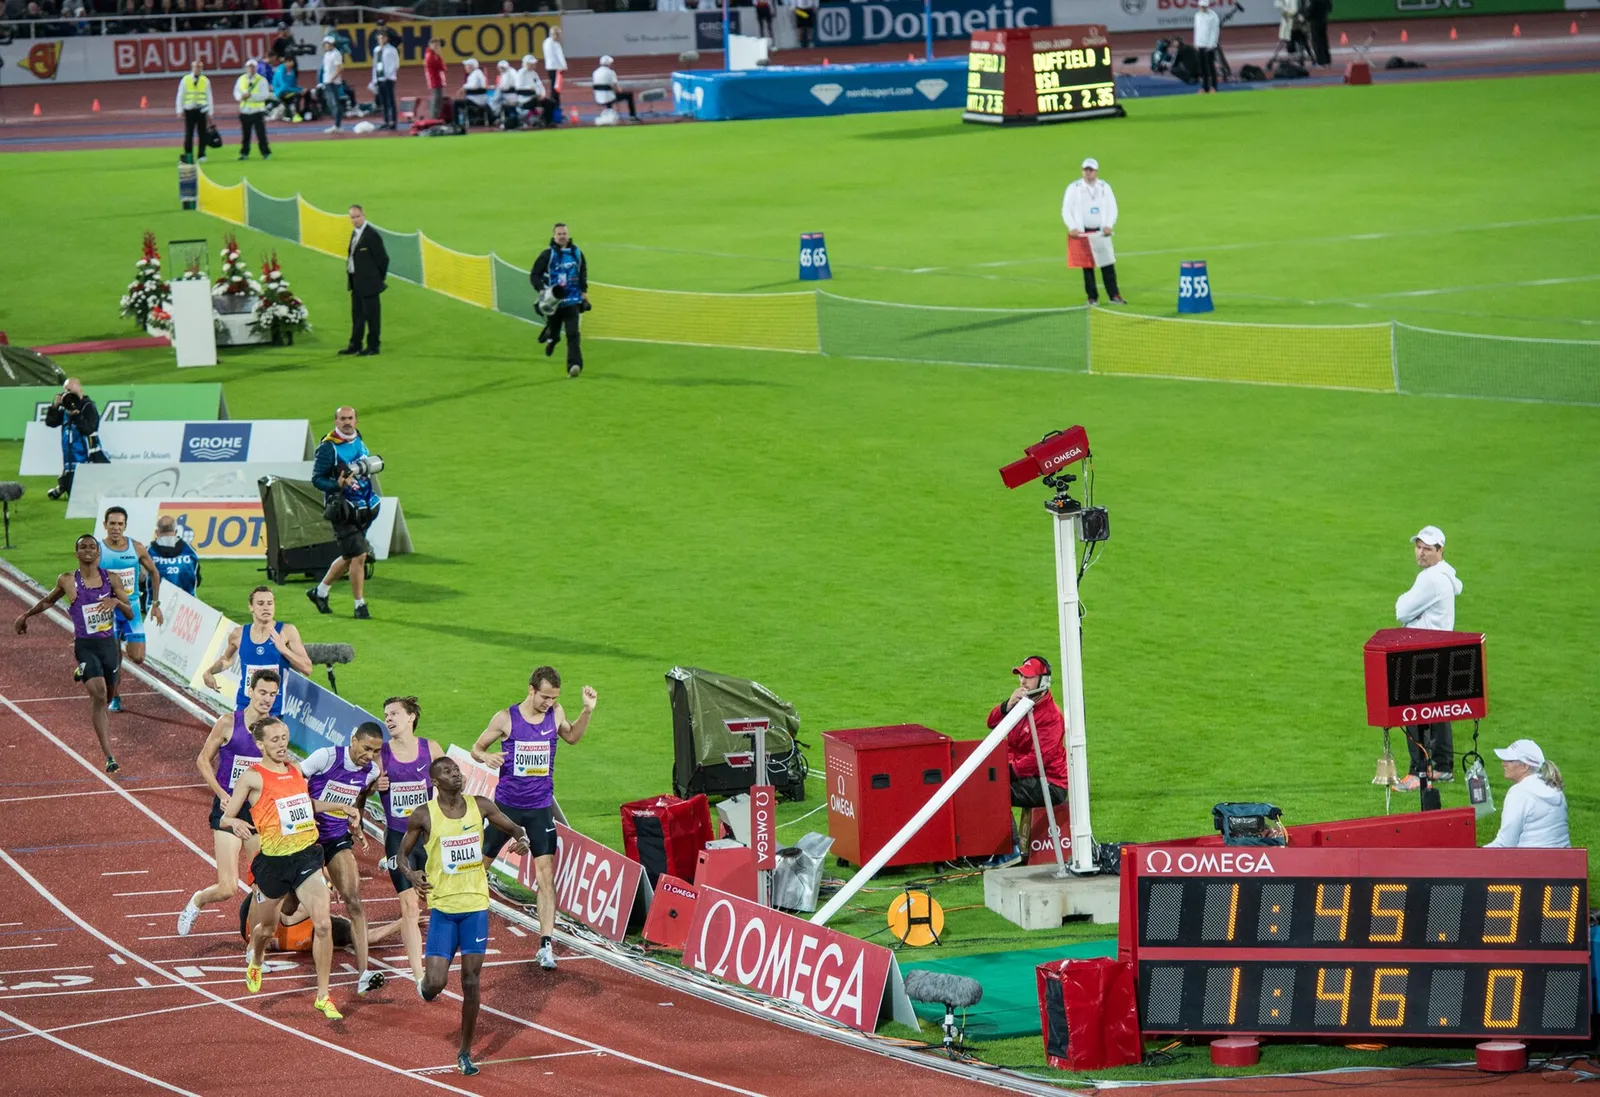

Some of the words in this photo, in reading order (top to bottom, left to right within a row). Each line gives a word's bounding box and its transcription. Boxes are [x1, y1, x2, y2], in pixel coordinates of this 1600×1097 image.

[862, 1, 1038, 39] Dometic
[117, 38, 270, 69] BAUHAU
[1033, 47, 1097, 72] DUFFIELD
[1101, 46, 1112, 66] J
[1034, 71, 1060, 90] USA
[1081, 86, 1115, 109] 2.35
[189, 437, 242, 448] GROHE
[1053, 447, 1082, 465] OMEGA
[152, 555, 191, 565] PHOTO
[166, 566, 179, 575] 20
[1420, 703, 1473, 720] OMEGA
[515, 753, 549, 766] SOWINSKI
[392, 793, 428, 808] ALMGREN
[830, 795, 855, 820] OMEGA
[757, 810, 768, 864] OMEGA
[1031, 838, 1073, 851] OMG
[450, 847, 476, 862] BALLA
[1177, 852, 1275, 873] OMEGA
[671, 887, 696, 900] OMEGA
[1227, 883, 1580, 944] 1:45.34
[737, 917, 866, 1027] OMEGA
[1227, 966, 1524, 1029] 1:46.0
